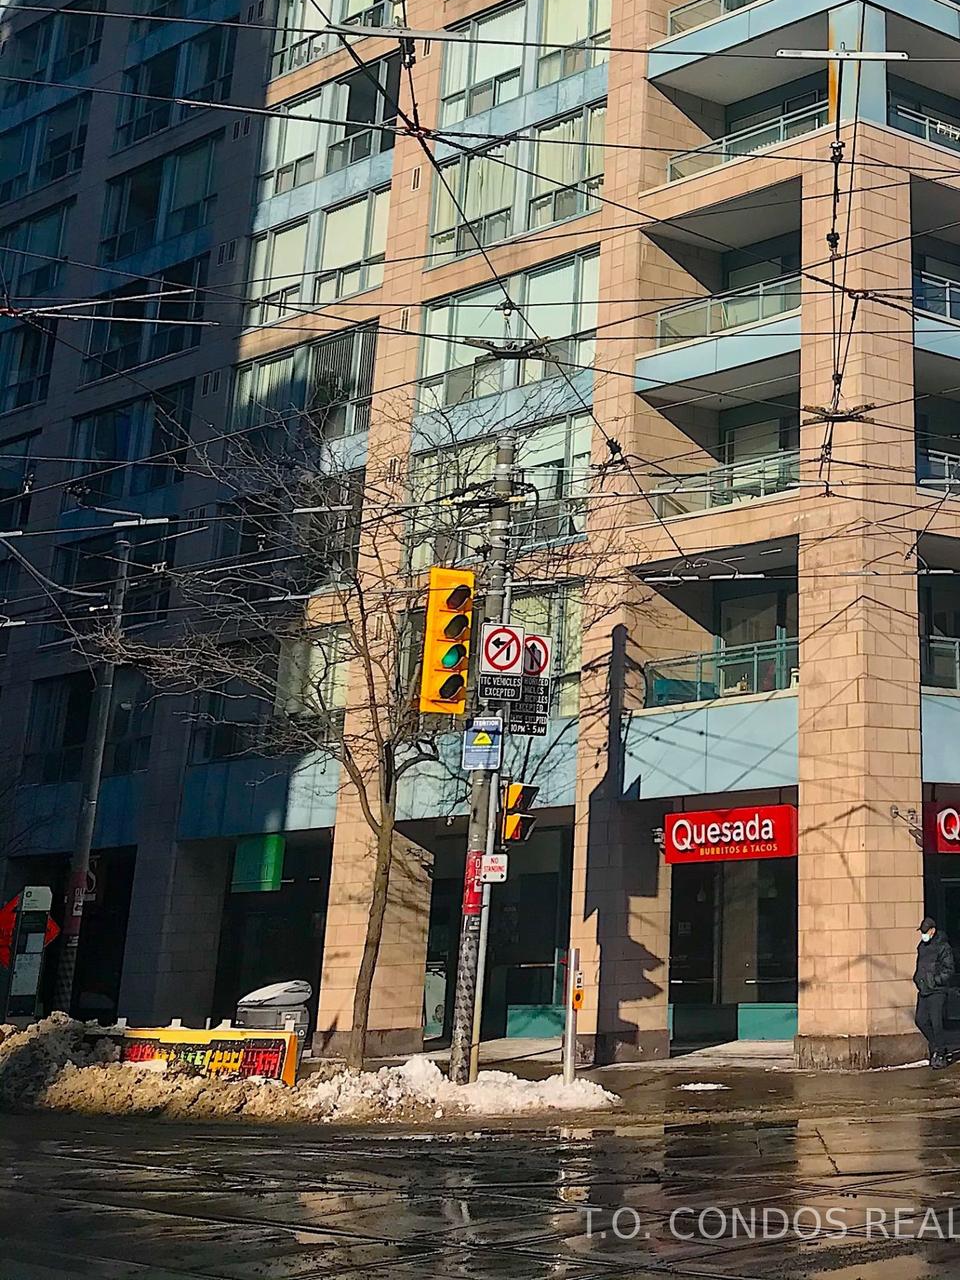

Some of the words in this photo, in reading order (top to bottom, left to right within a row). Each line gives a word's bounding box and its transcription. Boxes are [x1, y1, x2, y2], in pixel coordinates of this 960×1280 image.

[480, 676, 491, 685] TTC
[492, 677, 521, 687] VEHICLES
[484, 687, 516, 697] EXCEPTED
[672, 813, 774, 850] Quesada
[700, 845, 740, 856] BURRITOS
[750, 843, 778, 853] TACOS
[490, 857, 499, 865] NO
[483, 865, 505, 873] STANDING
